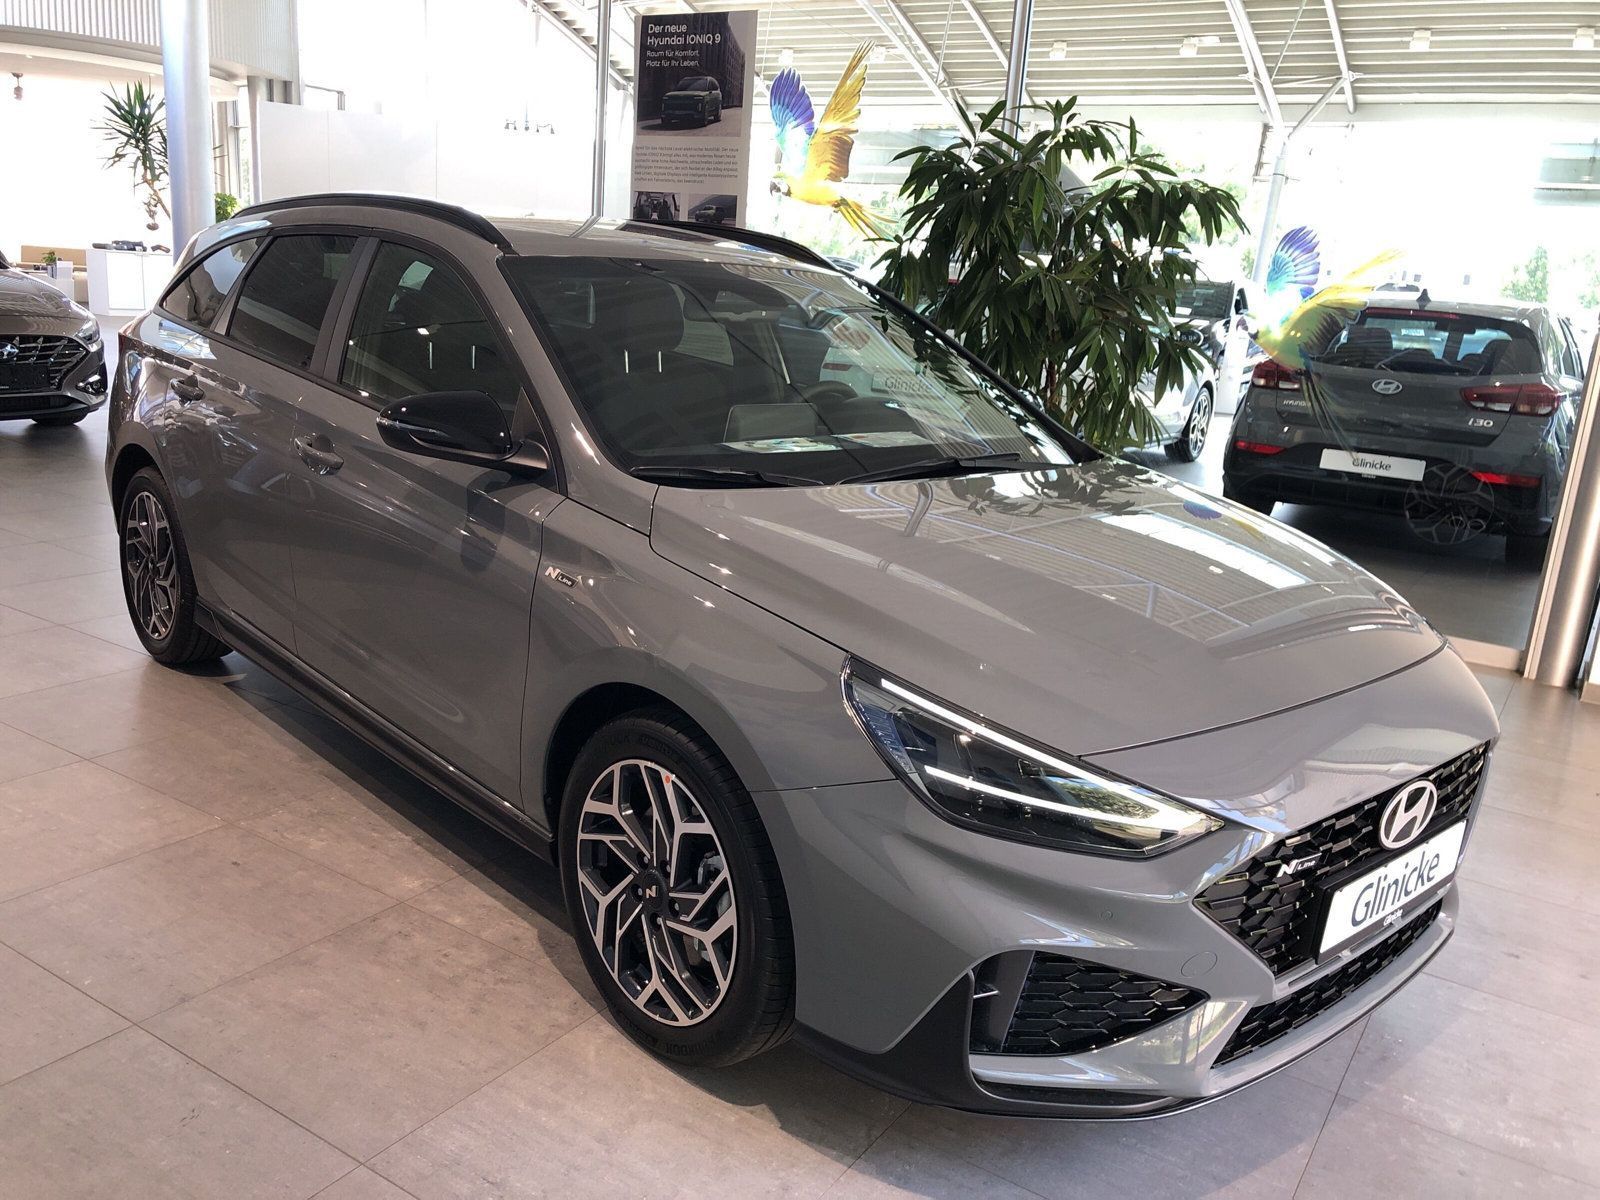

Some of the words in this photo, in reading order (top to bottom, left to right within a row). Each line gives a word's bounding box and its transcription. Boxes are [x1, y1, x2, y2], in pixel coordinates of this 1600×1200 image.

[648, 23, 663, 34] Der
[664, 24, 688, 33] neue
[647, 34, 685, 47] Hyundai
[686, 34, 713, 45] IONIQ
[714, 33, 721, 44] 9
[665, 49, 674, 57] für
[661, 59, 671, 67] für
[885, 375, 932, 393] Glinicke
[1352, 458, 1391, 471] Glinicke
[545, 566, 561, 580] N
[1276, 859, 1299, 878] N
[645, 885, 658, 899] N
[1351, 852, 1441, 927] Glinicke
